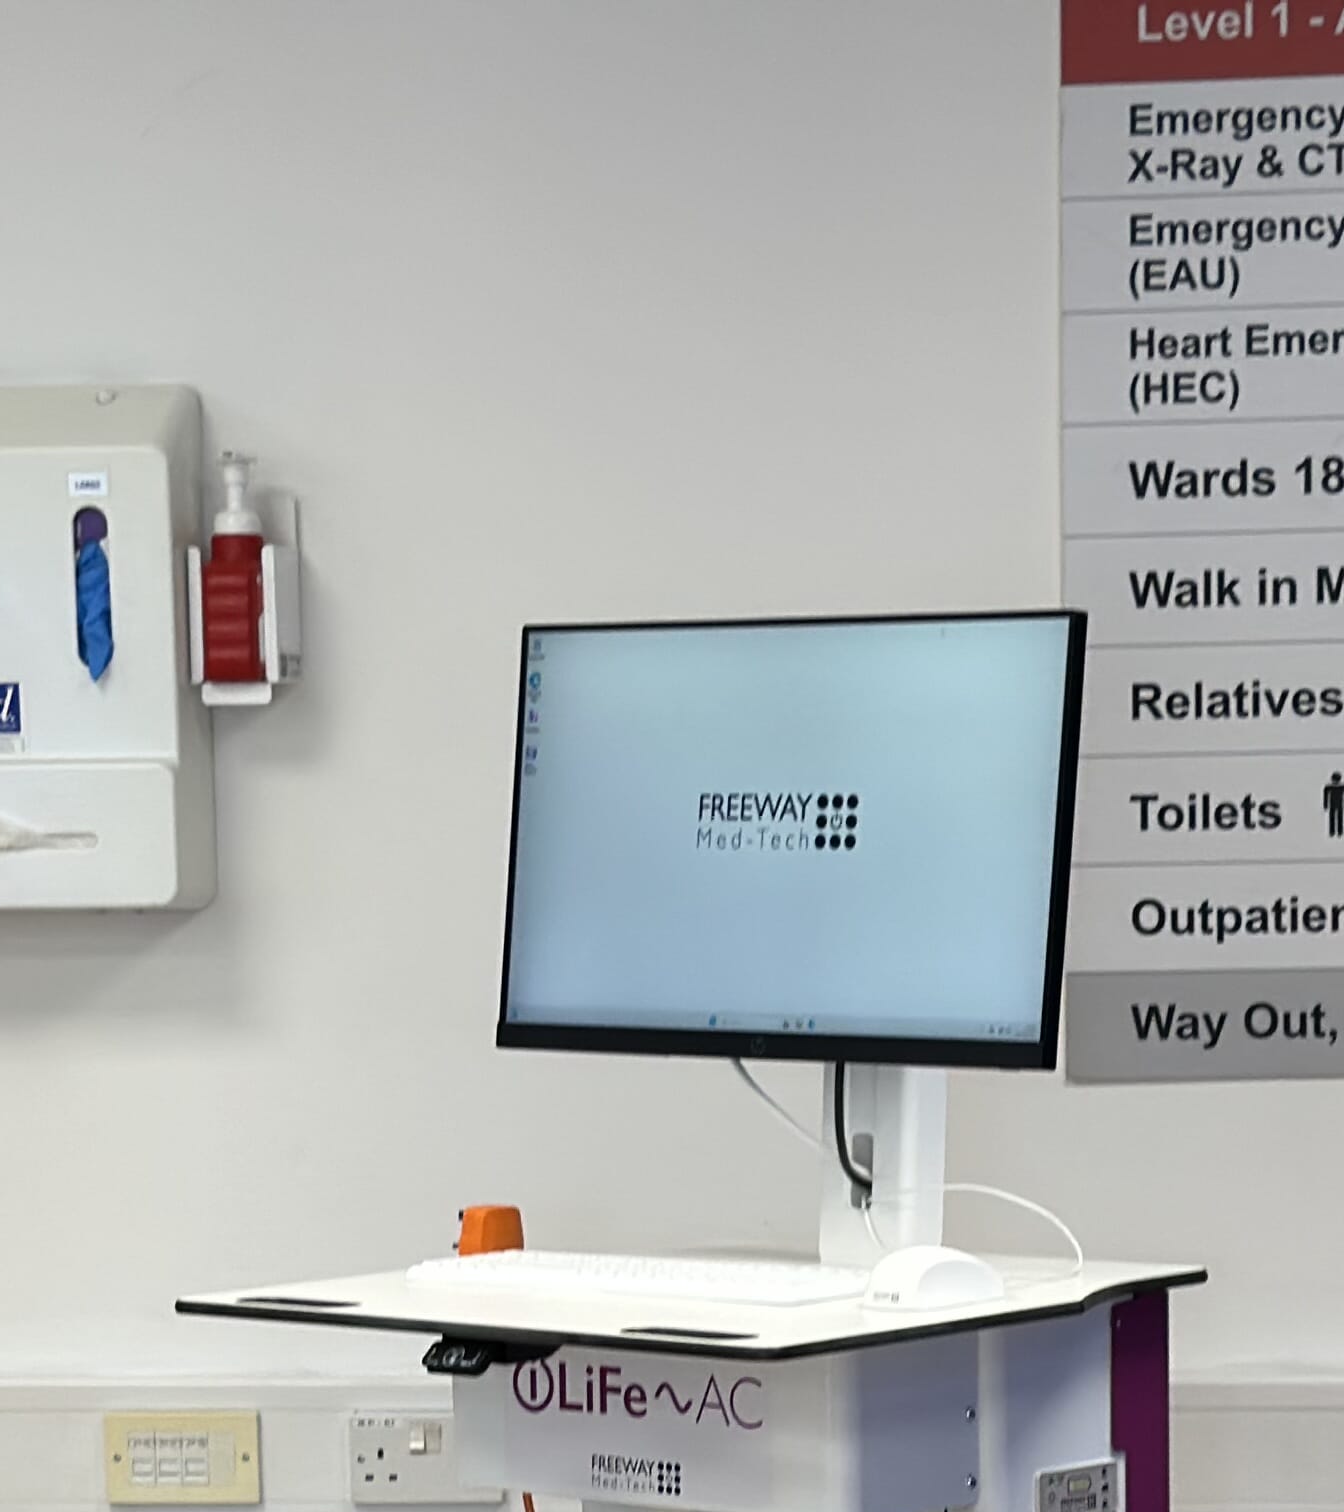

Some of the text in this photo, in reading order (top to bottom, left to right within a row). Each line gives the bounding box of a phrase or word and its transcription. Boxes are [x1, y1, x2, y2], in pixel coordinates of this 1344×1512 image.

[1137, 1, 1253, 43] Level
[1270, 3, 1290, 38] 1
[1308, 15, 1325, 27] -
[1128, 149, 1243, 187] X-Ray
[1256, 145, 1283, 178] &
[1129, 257, 1240, 300] (EAU)
[1130, 327, 1232, 360] Heart
[1129, 370, 1240, 413] (HEC)
[1130, 459, 1276, 499] Wards
[1130, 569, 1240, 609] Walk
[1258, 568, 1297, 606] in
[1132, 680, 1344, 721] Relatives
[698, 793, 812, 823] FREEWAY
[1129, 793, 1282, 831] Toilets
[696, 828, 810, 851] Med-Tech
[1130, 1003, 1228, 1051] Way
[1243, 1001, 1338, 1046] Out,
[591, 1453, 656, 1477] FREEWAY
